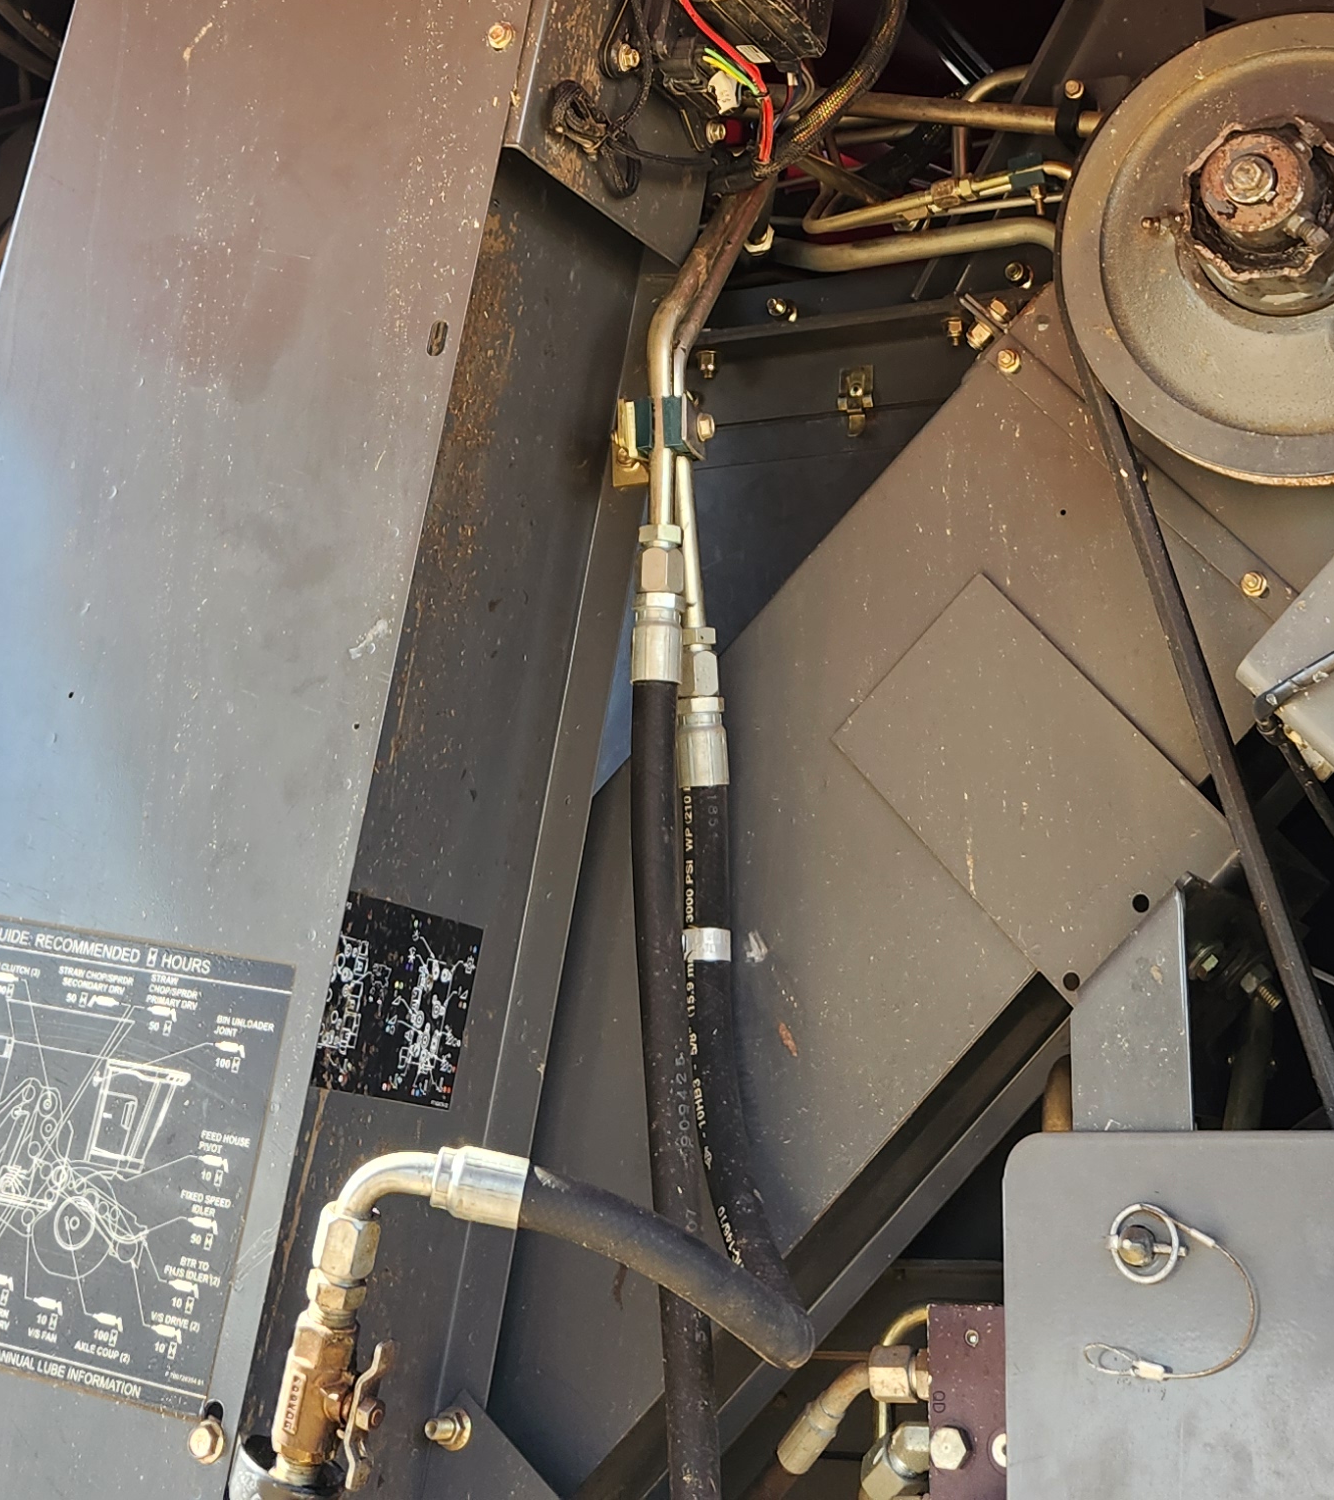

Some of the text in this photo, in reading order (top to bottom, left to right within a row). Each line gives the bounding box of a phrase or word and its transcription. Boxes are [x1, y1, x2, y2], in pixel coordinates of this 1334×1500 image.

[684, 795, 693, 825] (210
[685, 827, 694, 852] WP
[685, 859, 694, 885] PSI
[34, 933, 141, 963] RECOMMENDED
[161, 952, 211, 975] HOURS
[1, 961, 30, 976] CLUTCH
[59, 965, 86, 980] STRAW
[63, 976, 125, 995] SECONDARY DRV
[151, 974, 179, 986] STRAW
[65, 993, 77, 1004] 50
[146, 994, 199, 1011] PRIMARY DRV
[149, 1021, 159, 1032] 50
[217, 1014, 275, 1033] BIN UNLOADER
[213, 1026, 239, 1038] JOINT
[215, 1058, 231, 1070] 100
[201, 1130, 251, 1148] FEED HOUSE
[199, 1141, 223, 1154] PIVOT
[201, 1168, 212, 1181] 10
[180, 1188, 231, 1209] FIXED SPEED
[191, 1204, 216, 1218] IDLER
[190, 1233, 202, 1245] 50
[180, 1256, 209, 1272] BTR TO
[185, 1270, 210, 1284] IDLER
[210, 1274, 221, 1288] (2)
[171, 1296, 183, 1308] 10
[36, 1313, 47, 1325] 10
[151, 1310, 201, 1334] V/S DRIVE (2)
[27, 1328, 58, 1344] V/S FAN
[93, 1328, 109, 1342] 100
[74, 1340, 97, 1354] AXLE
[96, 1346, 120, 1360] COUP
[155, 1341, 166, 1353] 10
[37, 1361, 66, 1378] LUBE
[67, 1366, 141, 1399] INFORMATION
[933, 1390, 946, 1414] QD
